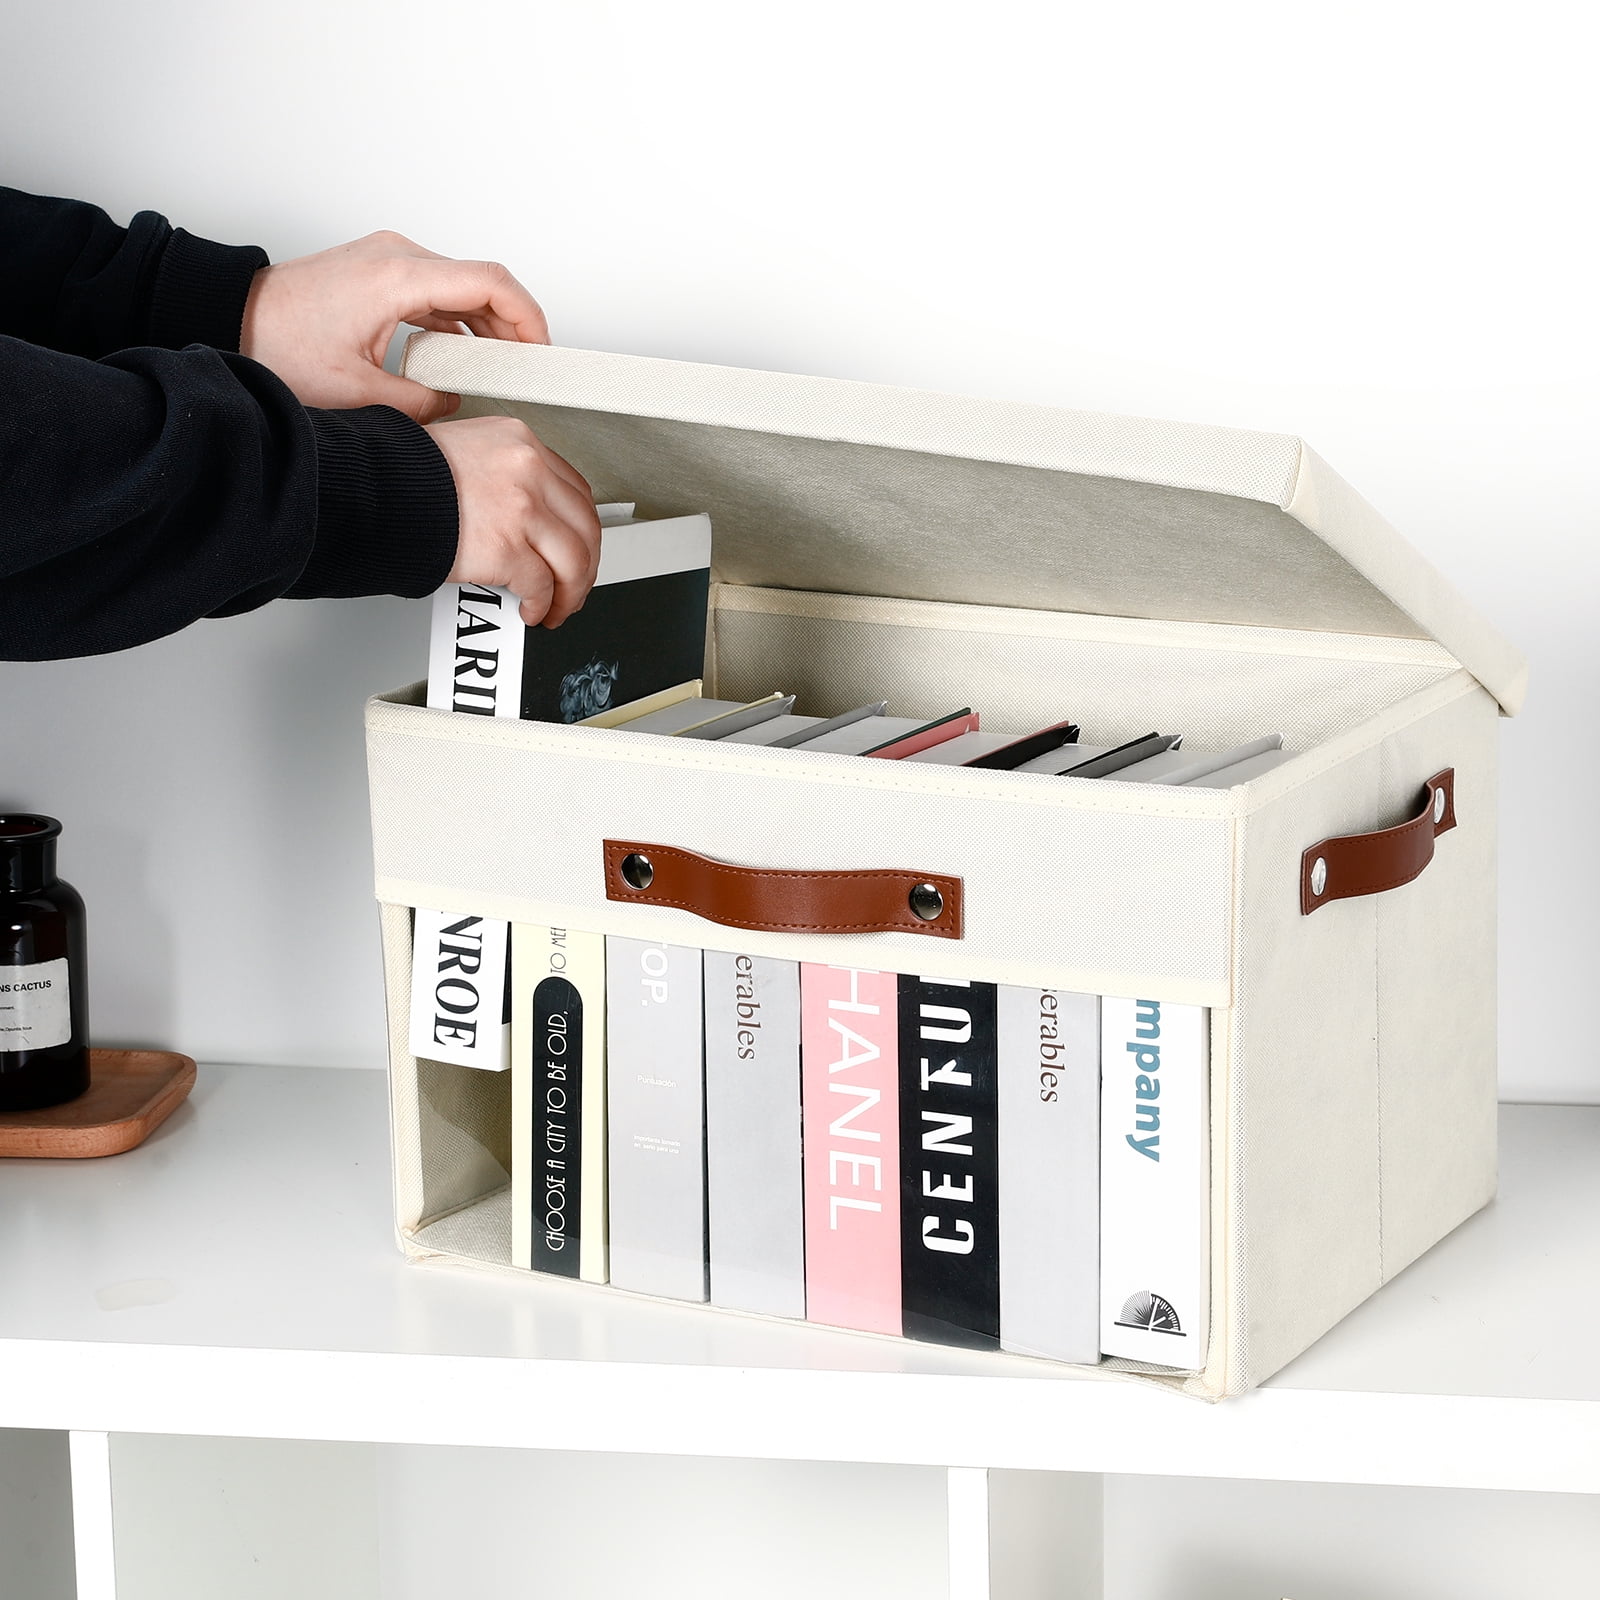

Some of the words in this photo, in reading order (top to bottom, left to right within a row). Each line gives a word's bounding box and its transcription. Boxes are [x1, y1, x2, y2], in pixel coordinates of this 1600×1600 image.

[13, 979, 52, 992] CACTUS
[550, 952, 567, 974] TO
[640, 943, 669, 1007] OP.
[547, 1010, 568, 1056] OLD,
[735, 955, 762, 1060] erables
[547, 1061, 567, 1081] BE
[1040, 988, 1066, 1103] erables
[546, 1087, 567, 1115] TO
[827, 964, 882, 1230] HANEL
[1125, 999, 1161, 1163] mpany
[546, 1120, 566, 1153] CITY
[919, 975, 974, 1256] CENTU
[546, 1159, 566, 1170] A
[546, 1174, 566, 1251] CHOOSE
